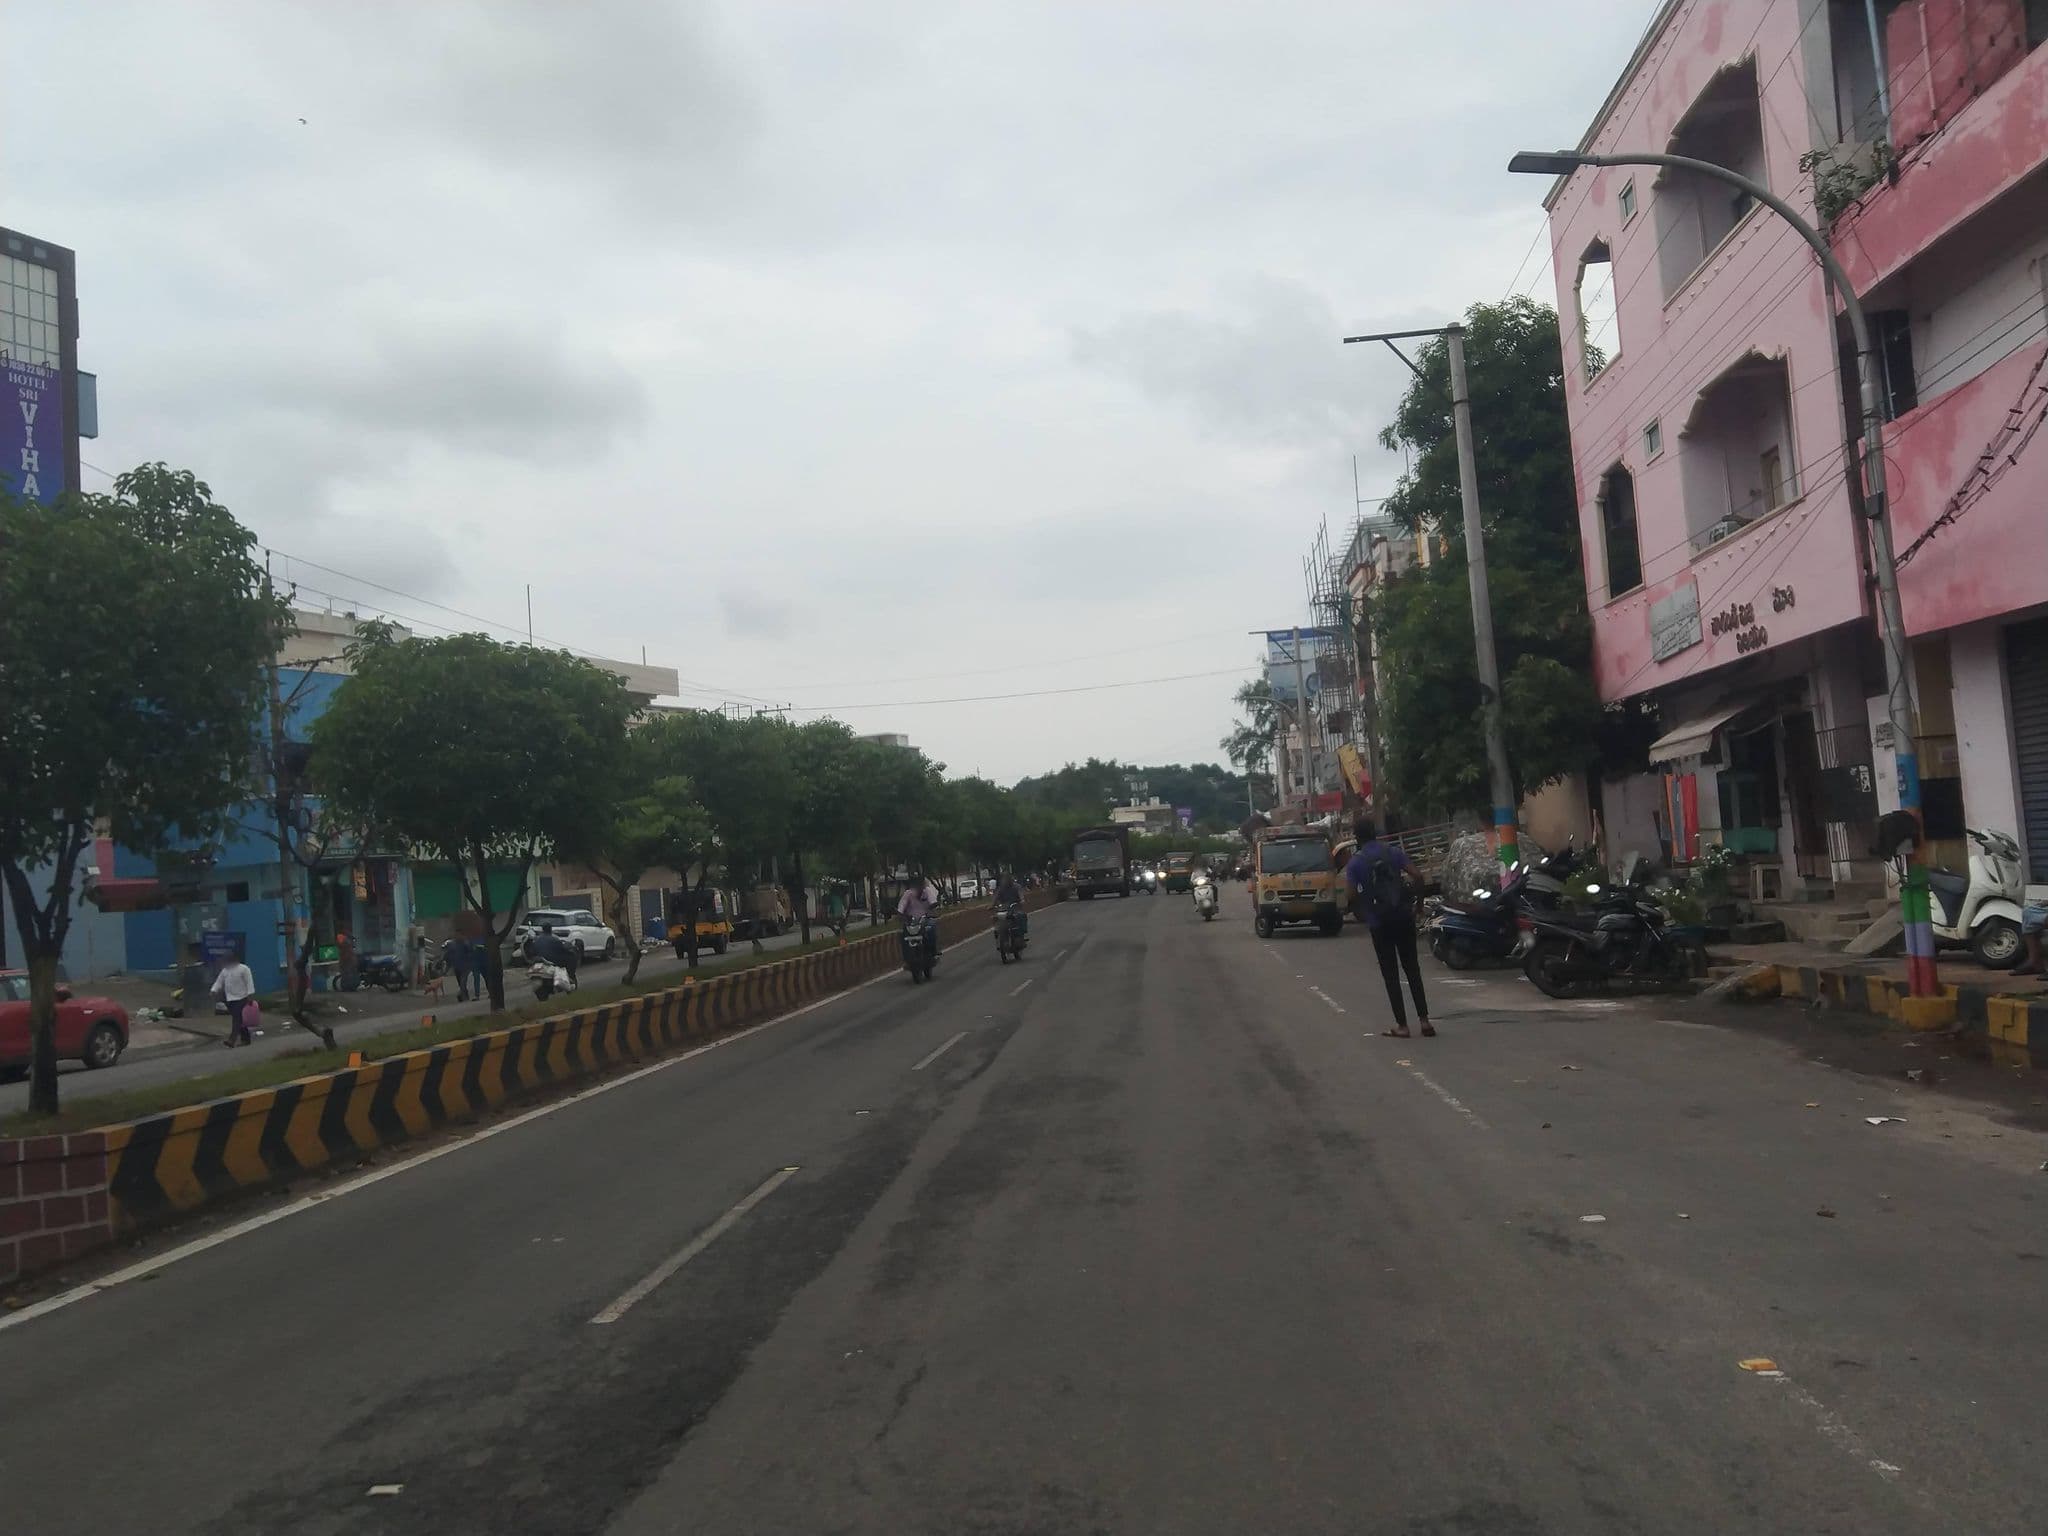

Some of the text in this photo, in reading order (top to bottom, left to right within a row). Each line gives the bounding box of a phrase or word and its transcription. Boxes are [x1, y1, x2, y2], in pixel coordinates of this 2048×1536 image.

[8, 371, 48, 392] HOTEL
[18, 387, 39, 401] SRI
[19, 400, 41, 500] VIHA
